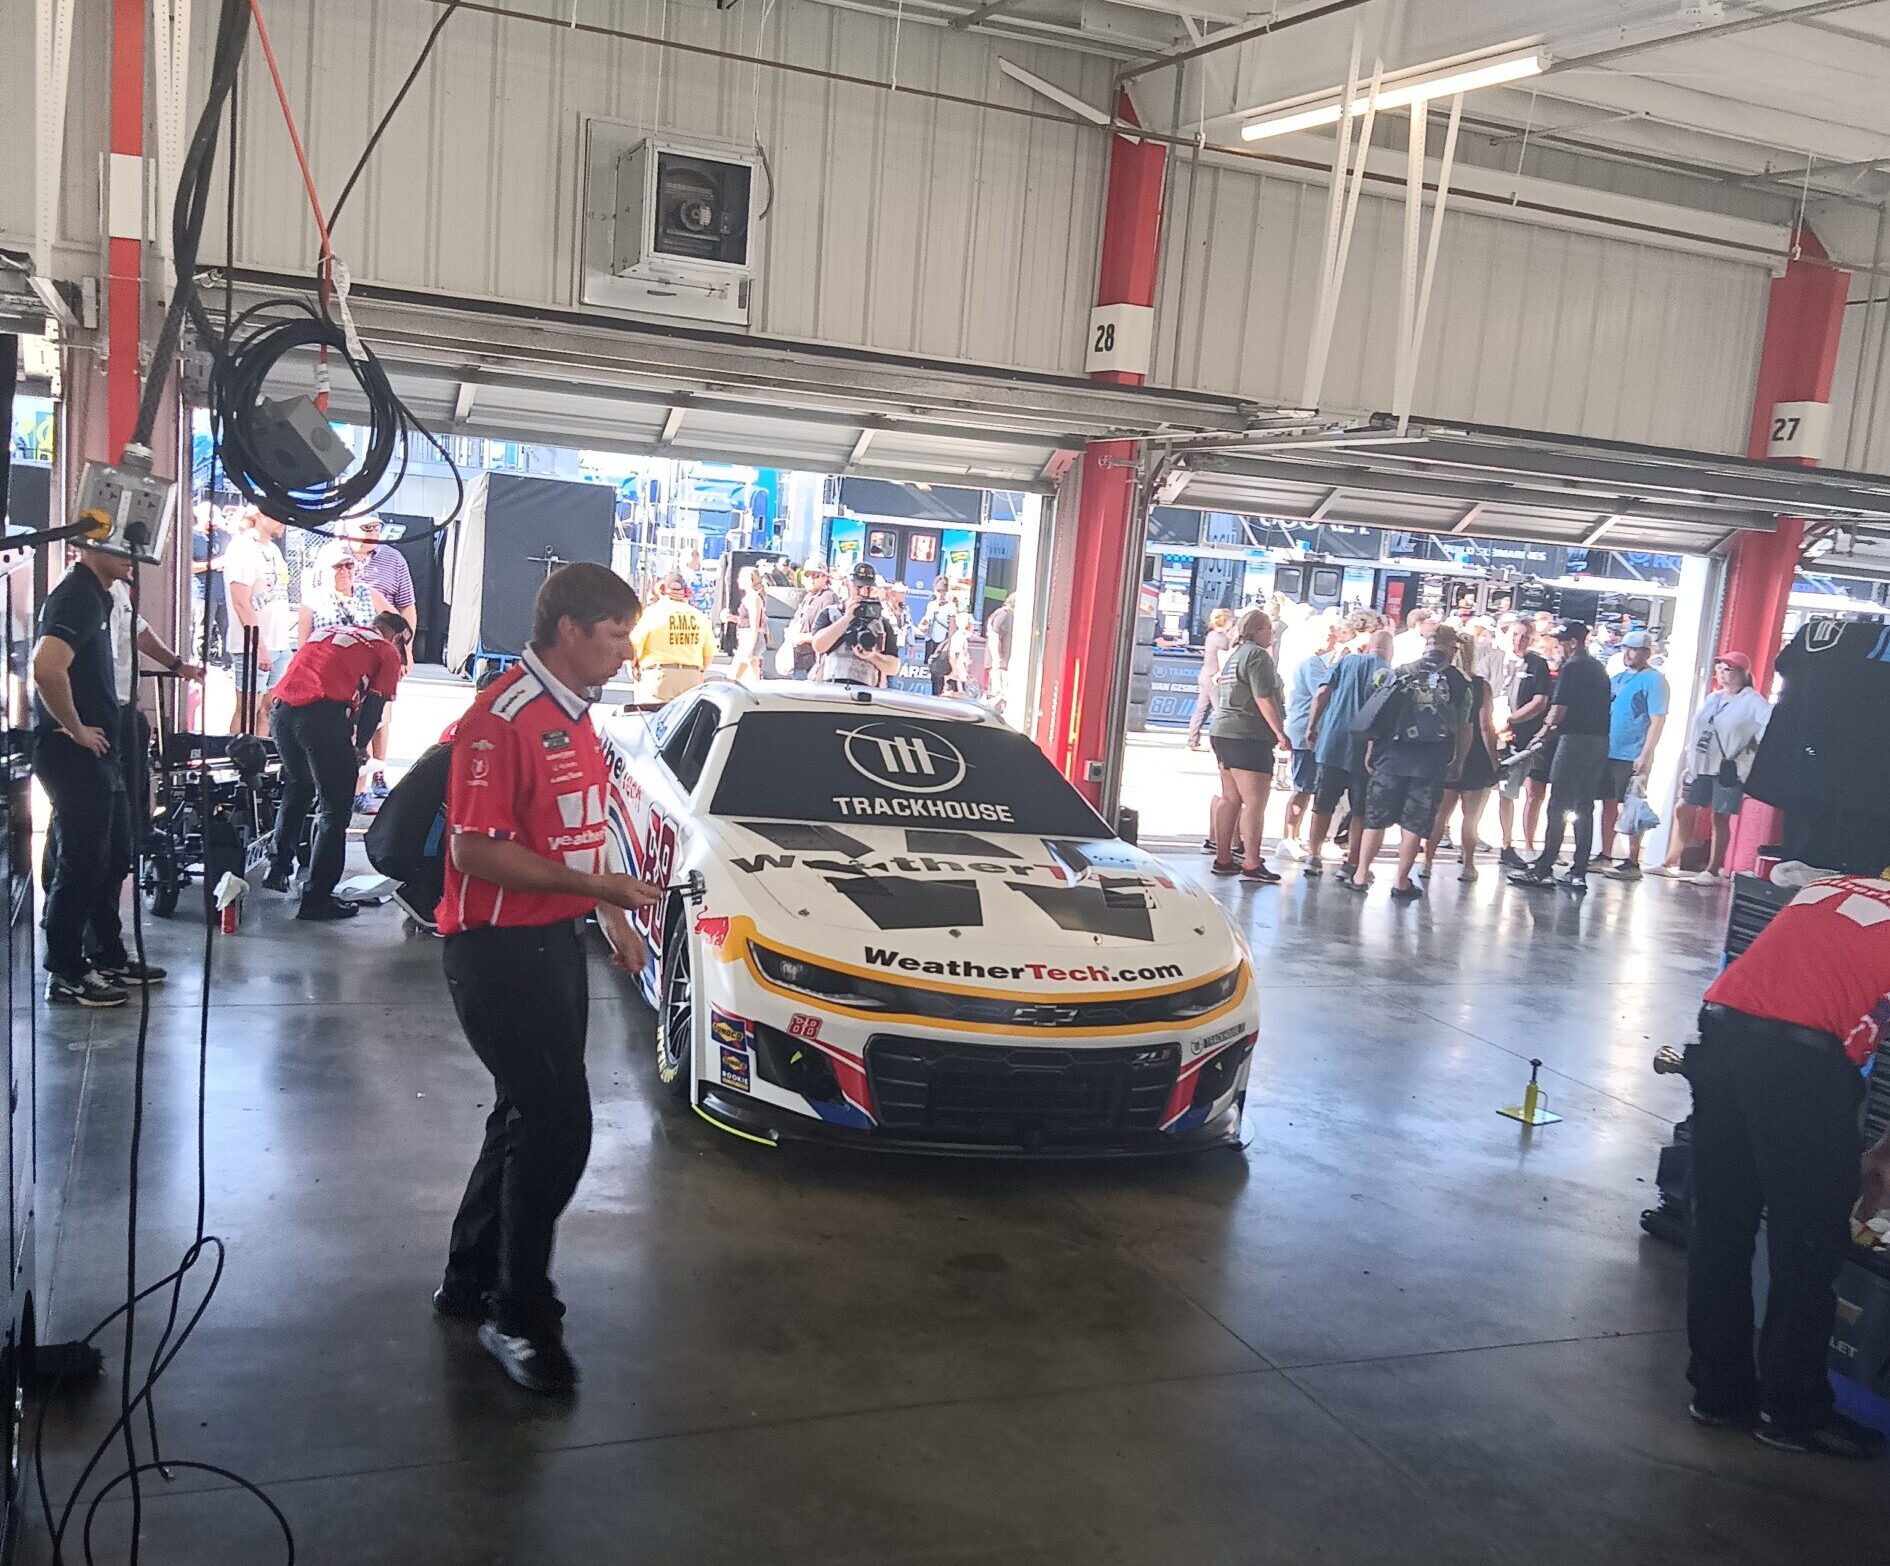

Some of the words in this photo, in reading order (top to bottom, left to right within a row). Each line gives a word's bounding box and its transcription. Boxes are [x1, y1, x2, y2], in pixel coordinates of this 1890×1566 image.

[1095, 323, 1115, 353] 28
[1771, 417, 1801, 441] 27
[669, 614, 700, 630] R.M.C.
[669, 632, 700, 646] EVENTS
[832, 796, 1015, 823] TRACKHOUSE
[864, 945, 1184, 983] WeatherTech.com
[712, 1021, 744, 1042] SUNOCO
[721, 1069, 749, 1086] ROOKIE
